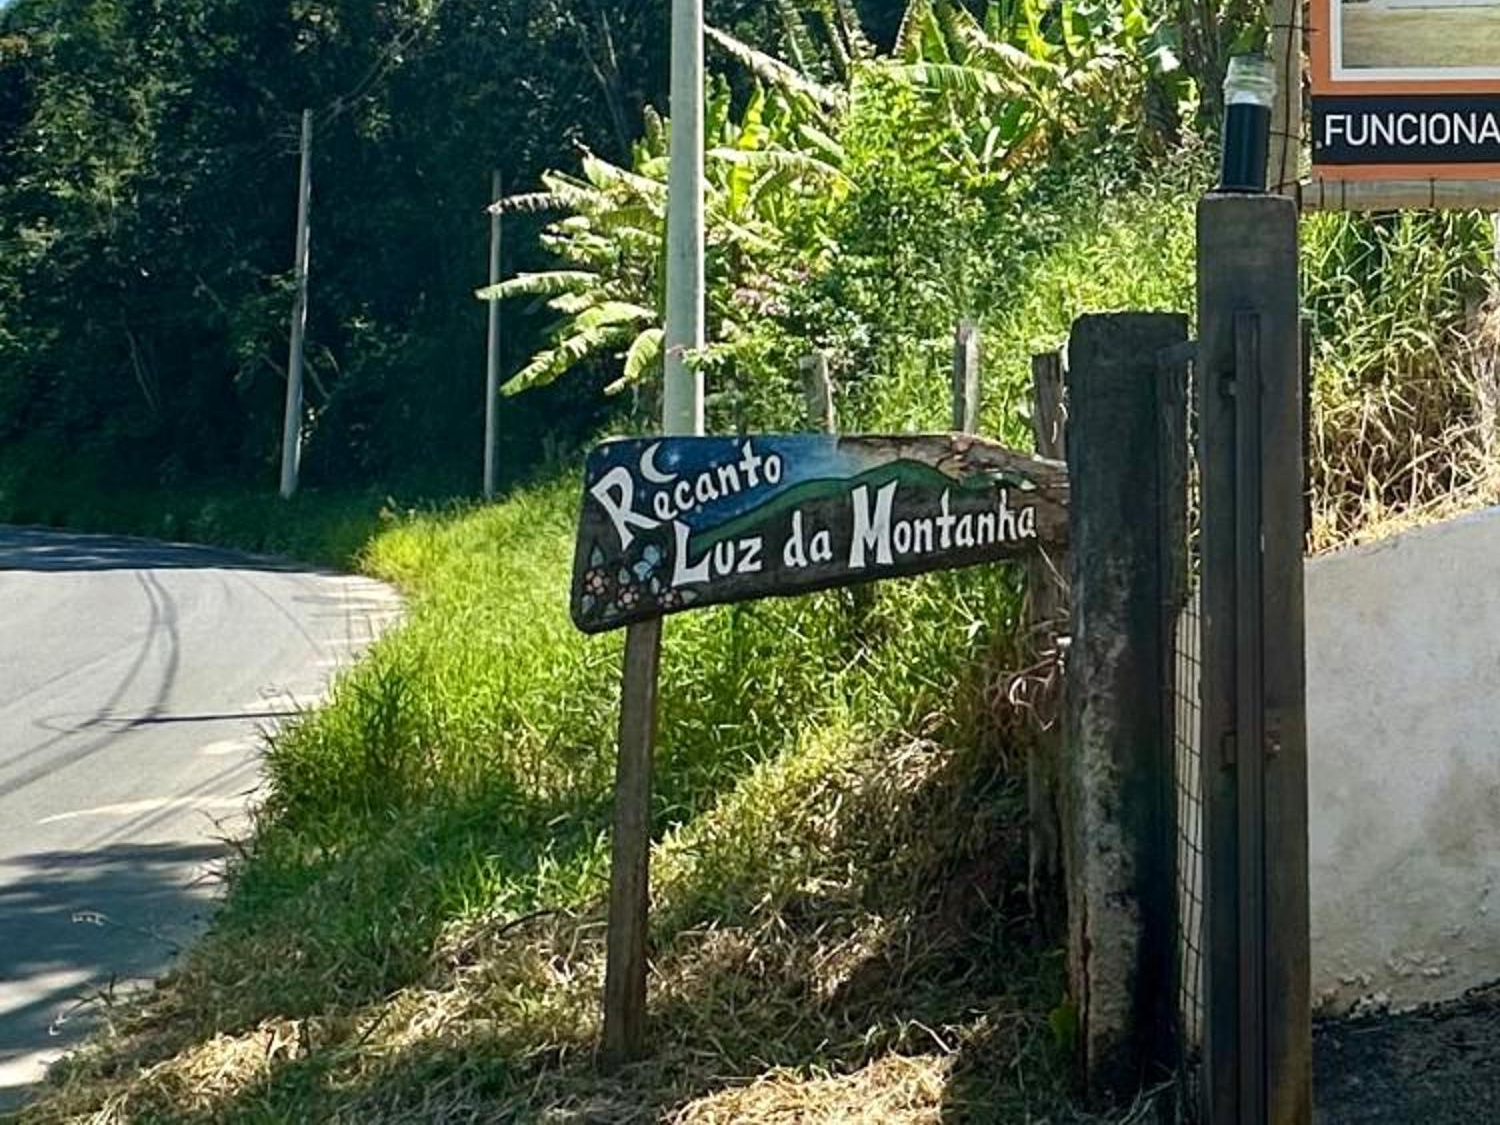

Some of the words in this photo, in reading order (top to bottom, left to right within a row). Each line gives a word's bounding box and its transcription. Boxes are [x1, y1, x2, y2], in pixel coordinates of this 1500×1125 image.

[590, 440, 784, 550] Recanto
[671, 519, 763, 587] Luz
[782, 511, 833, 570] da
[848, 480, 1037, 568] Montanha
